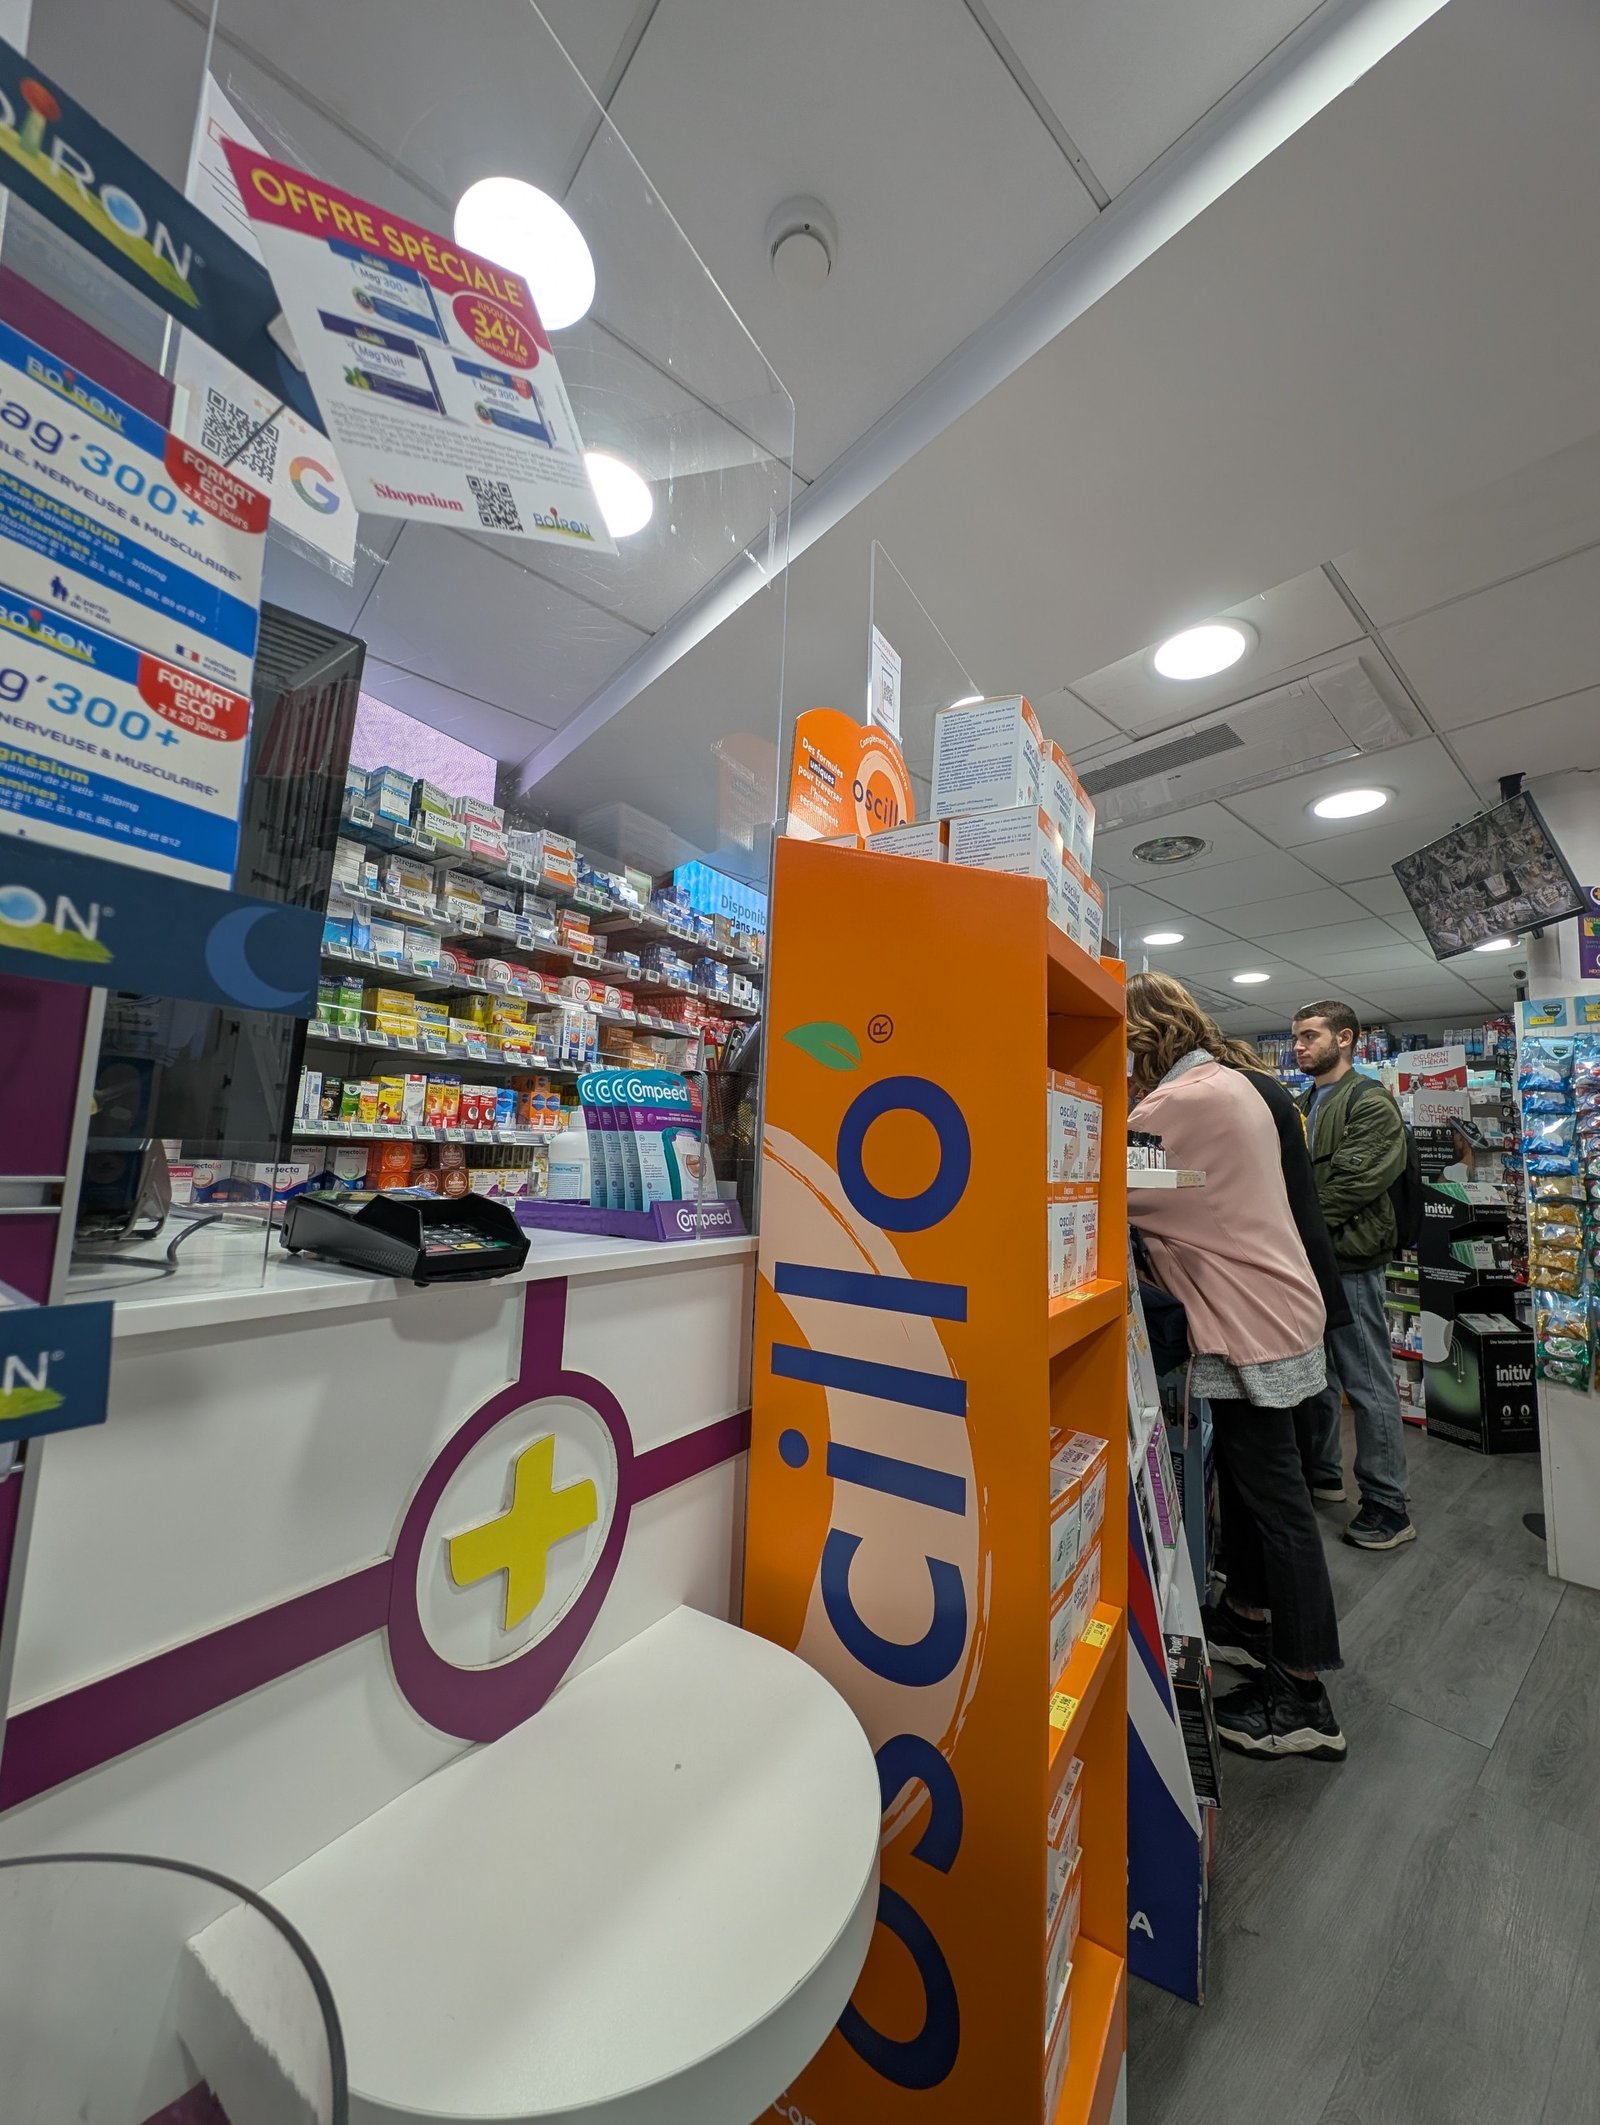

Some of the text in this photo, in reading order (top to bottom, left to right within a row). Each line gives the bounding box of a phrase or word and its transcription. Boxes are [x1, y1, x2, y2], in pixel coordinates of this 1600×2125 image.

[251, 167, 380, 248] OFFRE
[469, 307, 529, 357] 34%
[27, 355, 123, 424] BOIRON
[181, 449, 257, 506] FORMAT
[33, 458, 127, 521] NERVEUSE
[130, 514, 141, 528] &
[198, 476, 239, 510] ECO
[372, 481, 464, 512] Shopmium
[218, 502, 250, 531] jours
[533, 507, 592, 537] BOIRON
[157, 667, 235, 712] FORMAT
[174, 692, 216, 721] ECO
[178, 713, 195, 727] 20
[194, 718, 228, 740] jours
[100, 748, 112, 760] &
[802, 737, 844, 779] Des formules
[797, 764, 843, 804] pour traverser
[809, 759, 835, 786] uniques
[469, 798, 497, 815] Strepsils
[809, 785, 830, 807] l'hiver
[852, 779, 907, 827] oscill
[428, 812, 459, 830] Strepsils
[799, 794, 840, 828] sereinement
[473, 824, 502, 840] Strepsils
[546, 831, 571, 846] Strepsils
[394, 856, 426, 872] Strepsils
[547, 854, 572, 868] Strepsils
[448, 871, 477, 886] Strepsils
[451, 897, 479, 912] Strepsils
[721, 895, 766, 927] Disponib
[731, 915, 750, 935] dans
[493, 969, 510, 982] Drill
[1420, 1050, 1449, 1060] CLÉMENT
[627, 1078, 688, 1102] Compeed
[1060, 1104, 1078, 1120] oscillo
[1427, 1103, 1465, 1116] CLÉMENT
[677, 1209, 732, 1232] Compeed
[1424, 1202, 1453, 1215] initiv
[3, 1351, 49, 1396] N
[1496, 1363, 1532, 1381] initiv
[771, 1074, 972, 2091] oscillo
